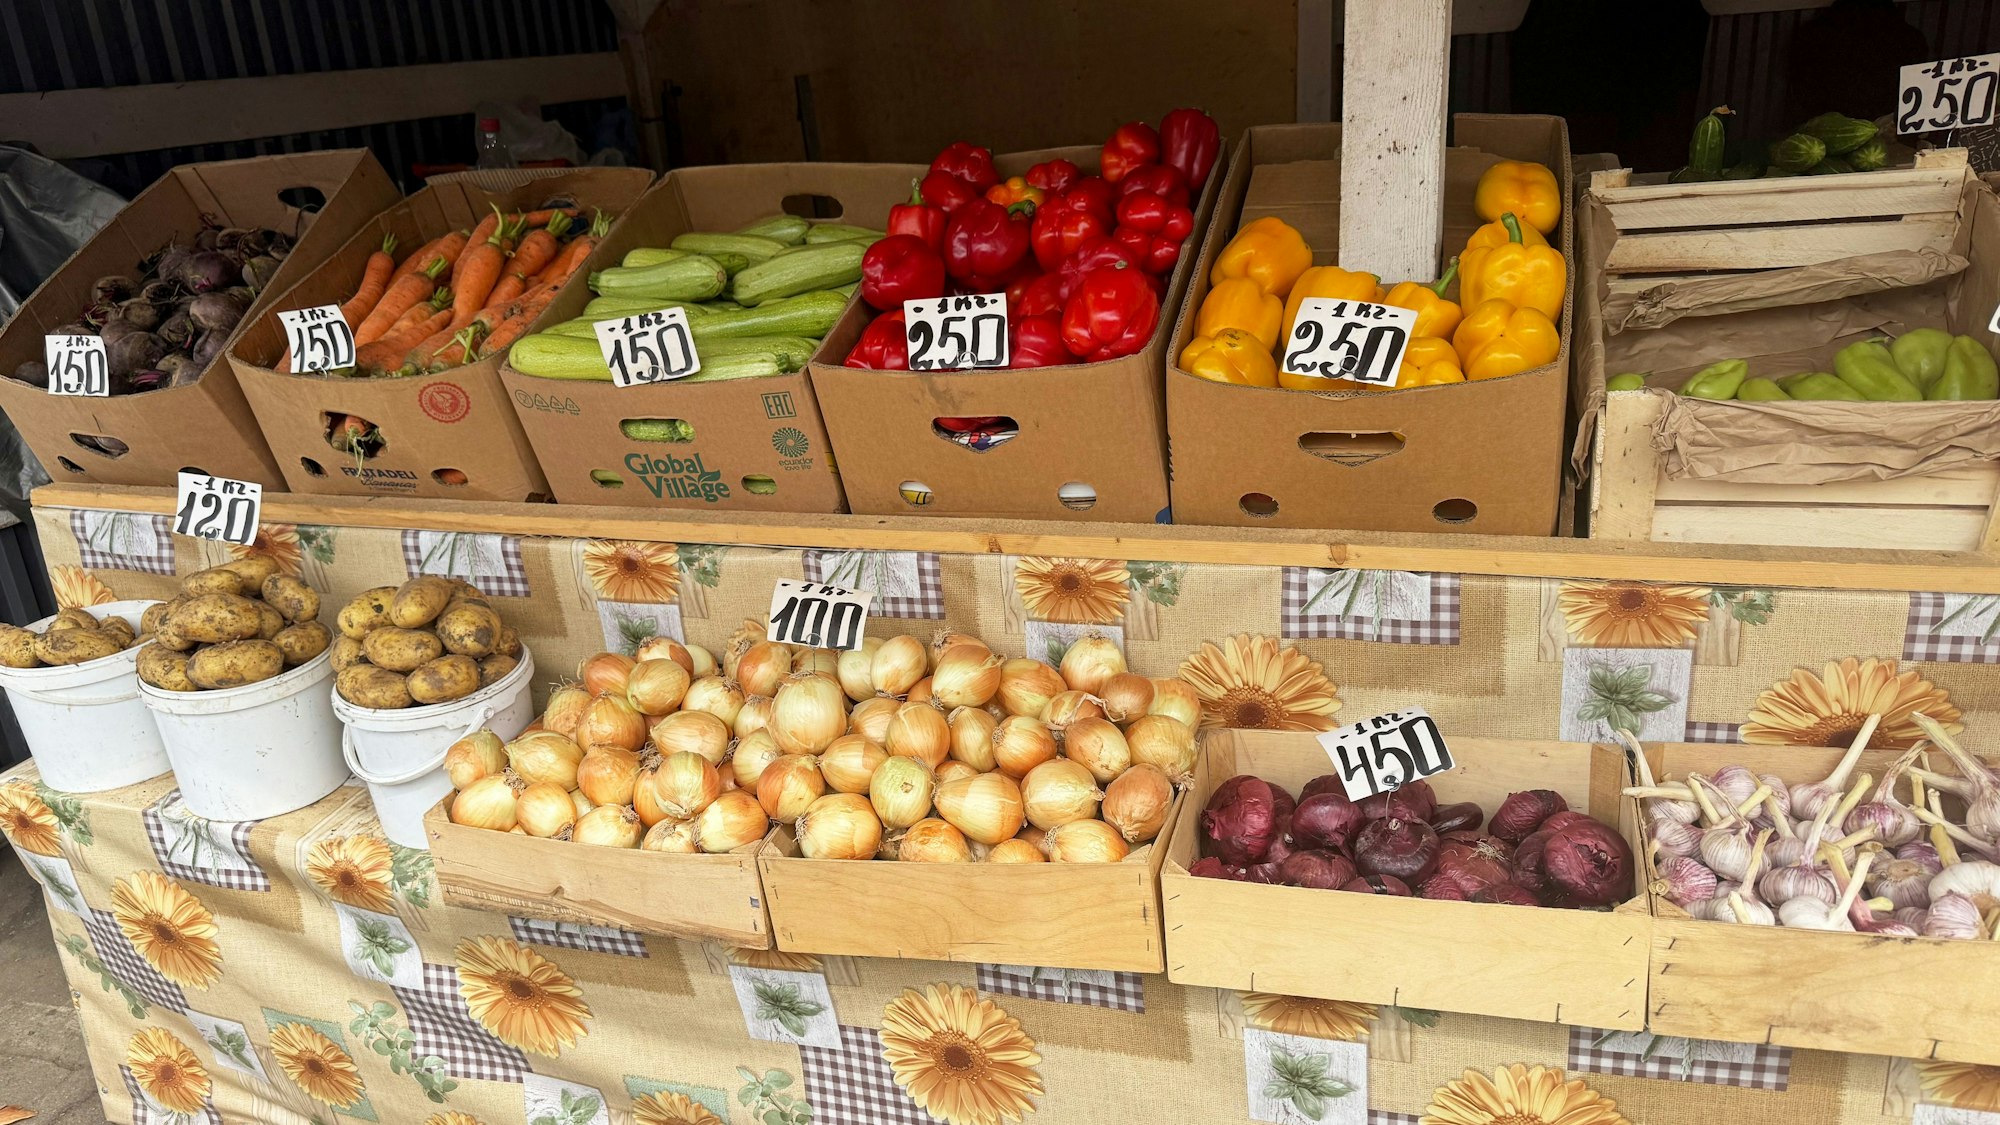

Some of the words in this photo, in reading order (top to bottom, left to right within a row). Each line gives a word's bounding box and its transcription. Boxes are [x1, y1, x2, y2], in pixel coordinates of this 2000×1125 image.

[1899, 71, 1998, 132] 250
[293, 320, 353, 372] 150
[608, 323, 693, 384] 150
[908, 314, 1005, 370] 250
[1286, 320, 1406, 381] 250
[51, 349, 105, 394] 150
[624, 453, 706, 475] Global
[638, 475, 731, 502] Village
[177, 491, 255, 545] 120
[770, 597, 863, 650] 100
[1336, 716, 1452, 795] 450
